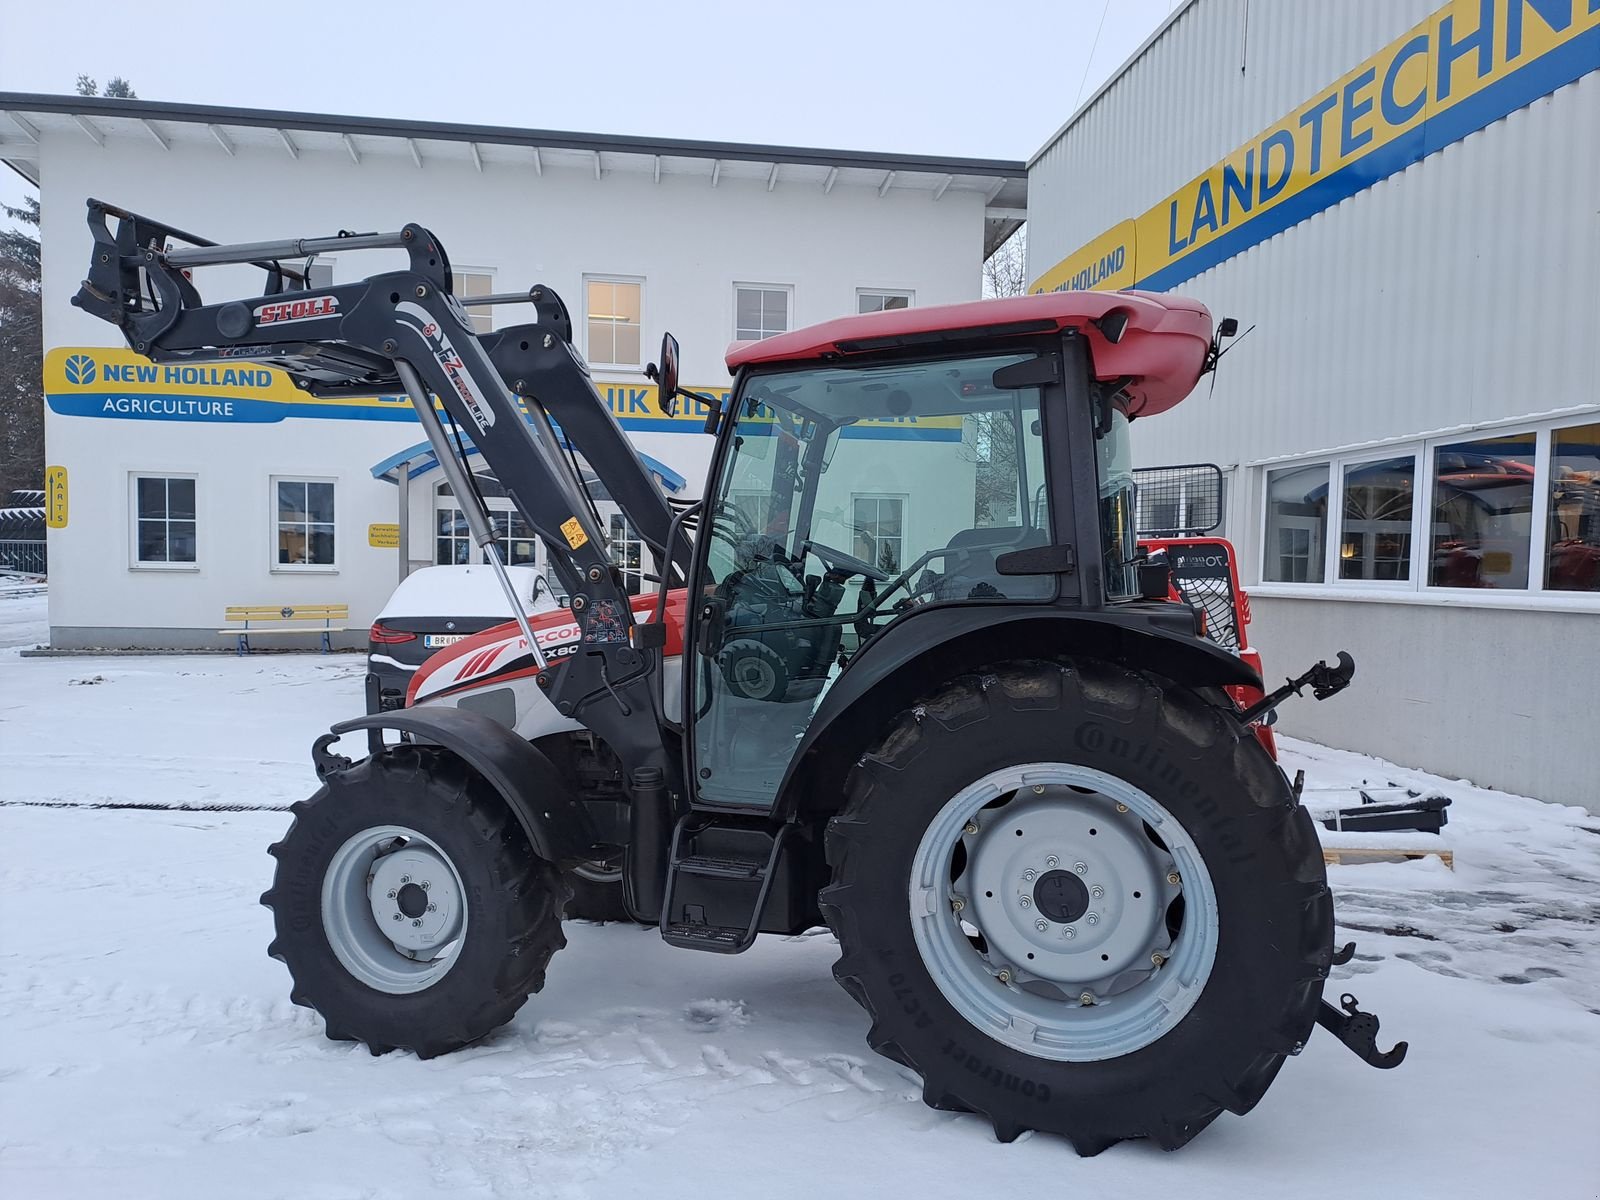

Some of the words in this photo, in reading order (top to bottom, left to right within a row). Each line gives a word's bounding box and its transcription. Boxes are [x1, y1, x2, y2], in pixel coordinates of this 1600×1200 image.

[1072, 245, 1125, 291] HOLLAND
[261, 299, 335, 323] STOLL
[103, 364, 158, 383] NEW
[166, 366, 272, 388] HOLLAND
[102, 398, 234, 416] AGRICULTURE
[434, 636, 445, 645] BR
[541, 645, 579, 659] X80
[1075, 720, 1254, 864] Continental
